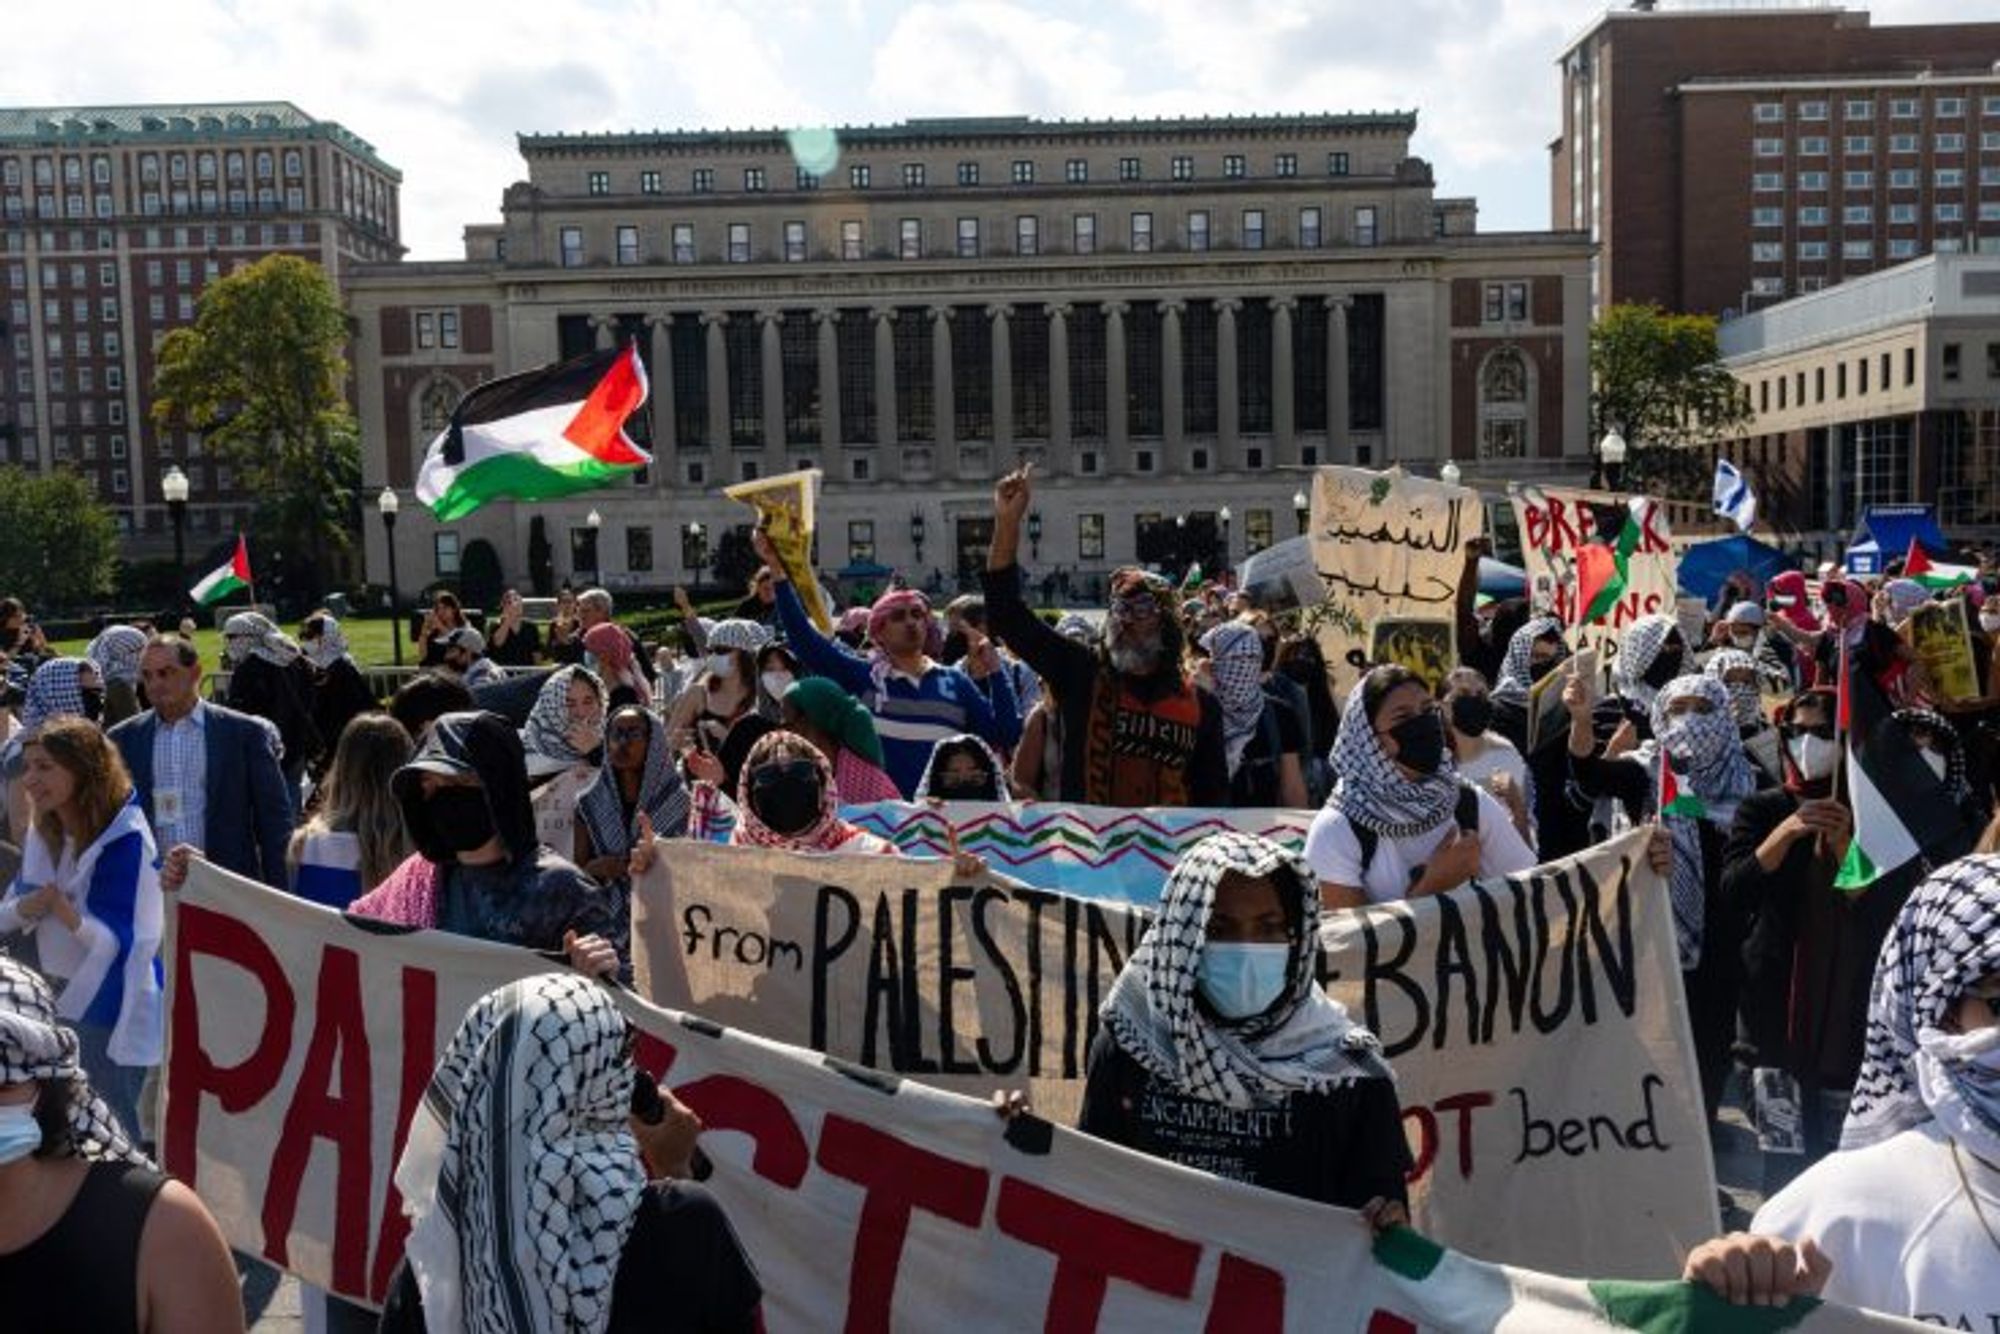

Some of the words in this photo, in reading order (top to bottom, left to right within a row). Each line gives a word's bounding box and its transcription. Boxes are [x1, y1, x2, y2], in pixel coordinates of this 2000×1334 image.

[1525, 495, 1669, 553] BREK
[937, 676, 957, 700] C
[683, 904, 802, 973] from
[811, 886, 1156, 1079] PALESTIN
[1400, 1090, 1495, 1184] OT
[1509, 1073, 1670, 1164] bend
